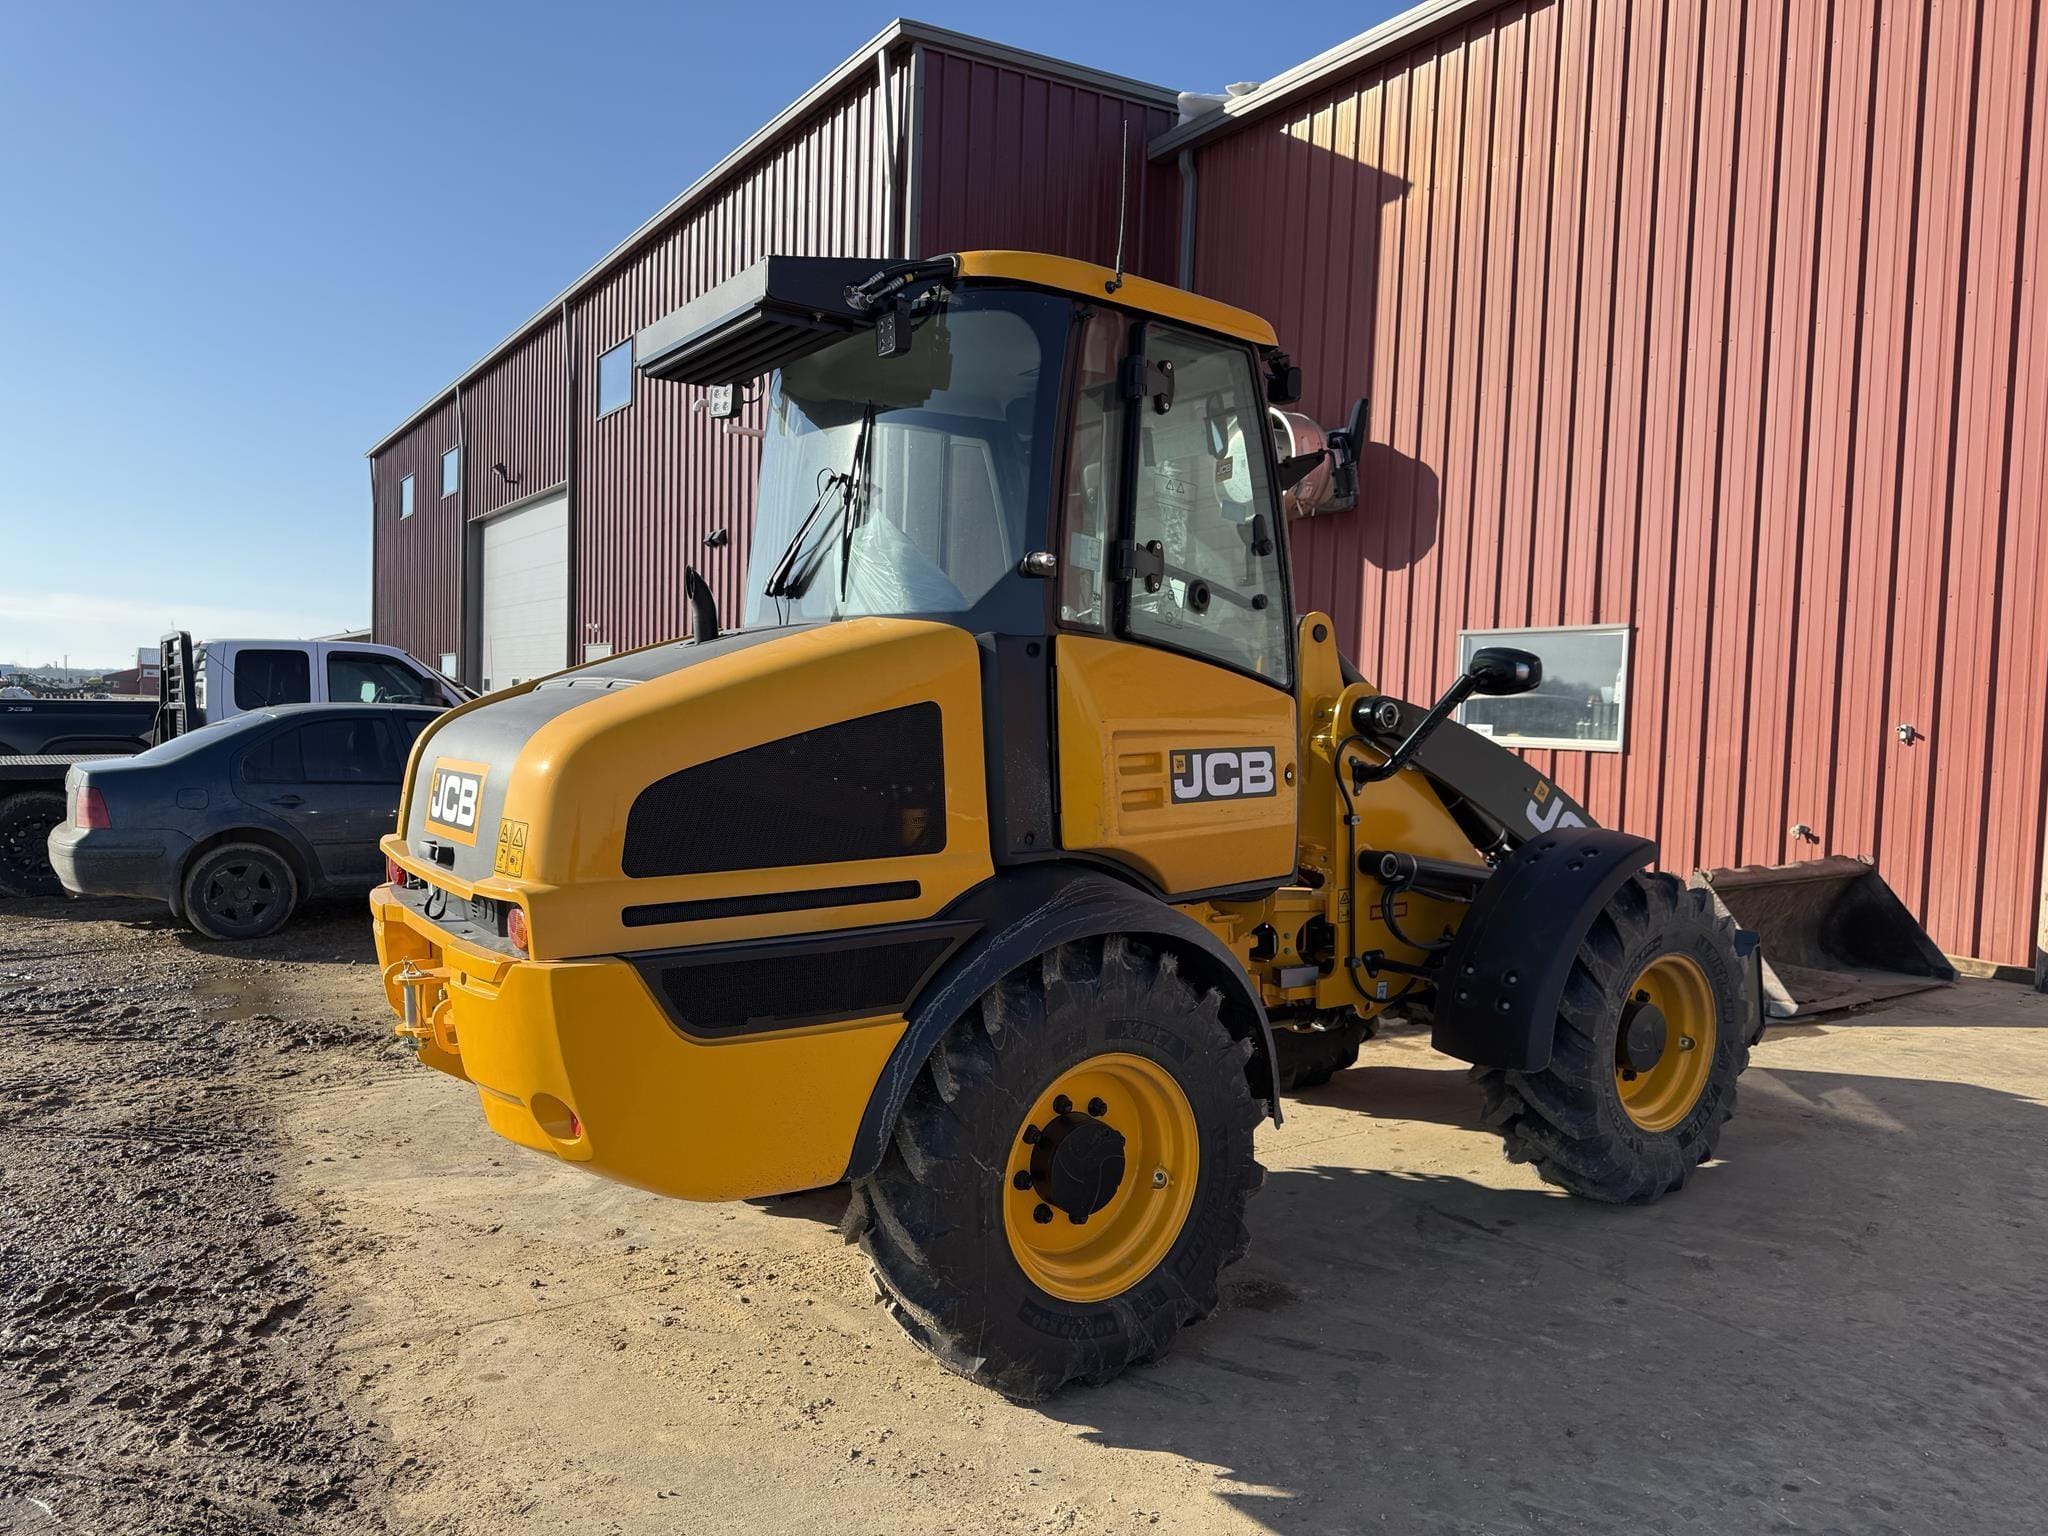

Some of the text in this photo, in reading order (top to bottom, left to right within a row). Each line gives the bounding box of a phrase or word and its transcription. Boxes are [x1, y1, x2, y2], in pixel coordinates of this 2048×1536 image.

[1216, 463, 1231, 476] JCB
[1174, 751, 1274, 799] JCB
[431, 774, 478, 827] JCB
